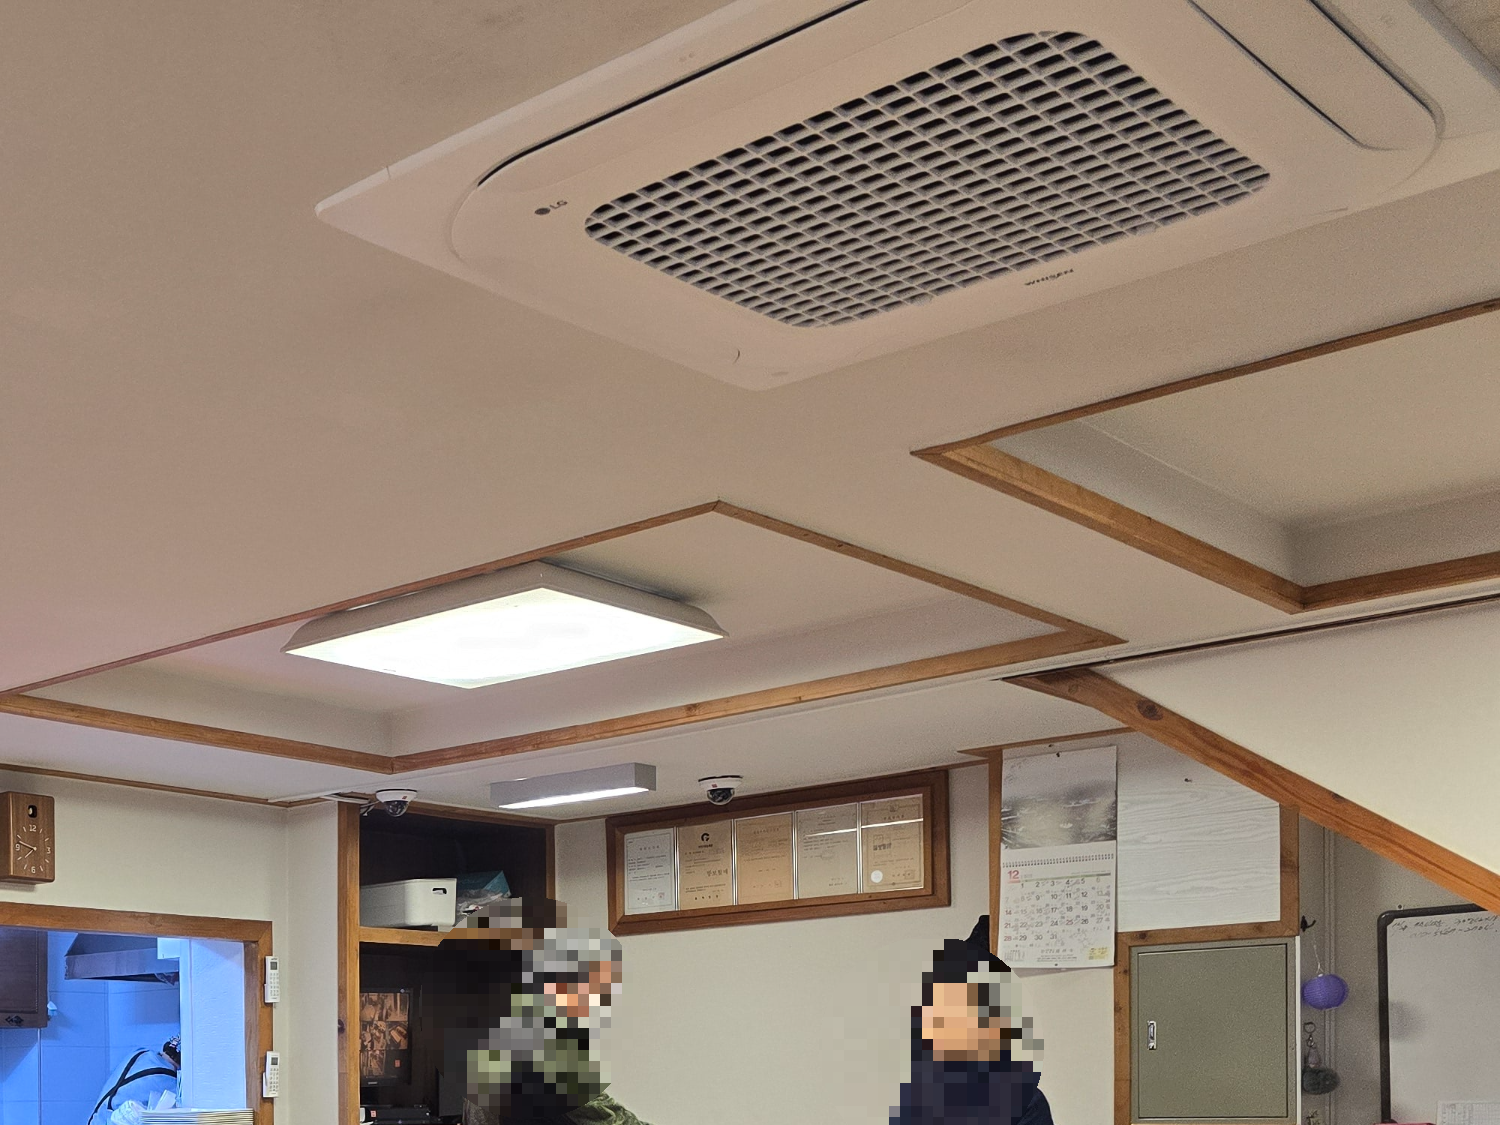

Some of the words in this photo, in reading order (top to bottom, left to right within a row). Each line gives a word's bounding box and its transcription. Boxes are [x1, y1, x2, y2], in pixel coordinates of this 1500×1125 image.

[550, 200, 568, 209] LG
[29, 824, 37, 832] 12
[15, 843, 21, 851] 9
[46, 846, 51, 854] 3
[31, 866, 36, 874] 6
[1008, 870, 1019, 879] 12
